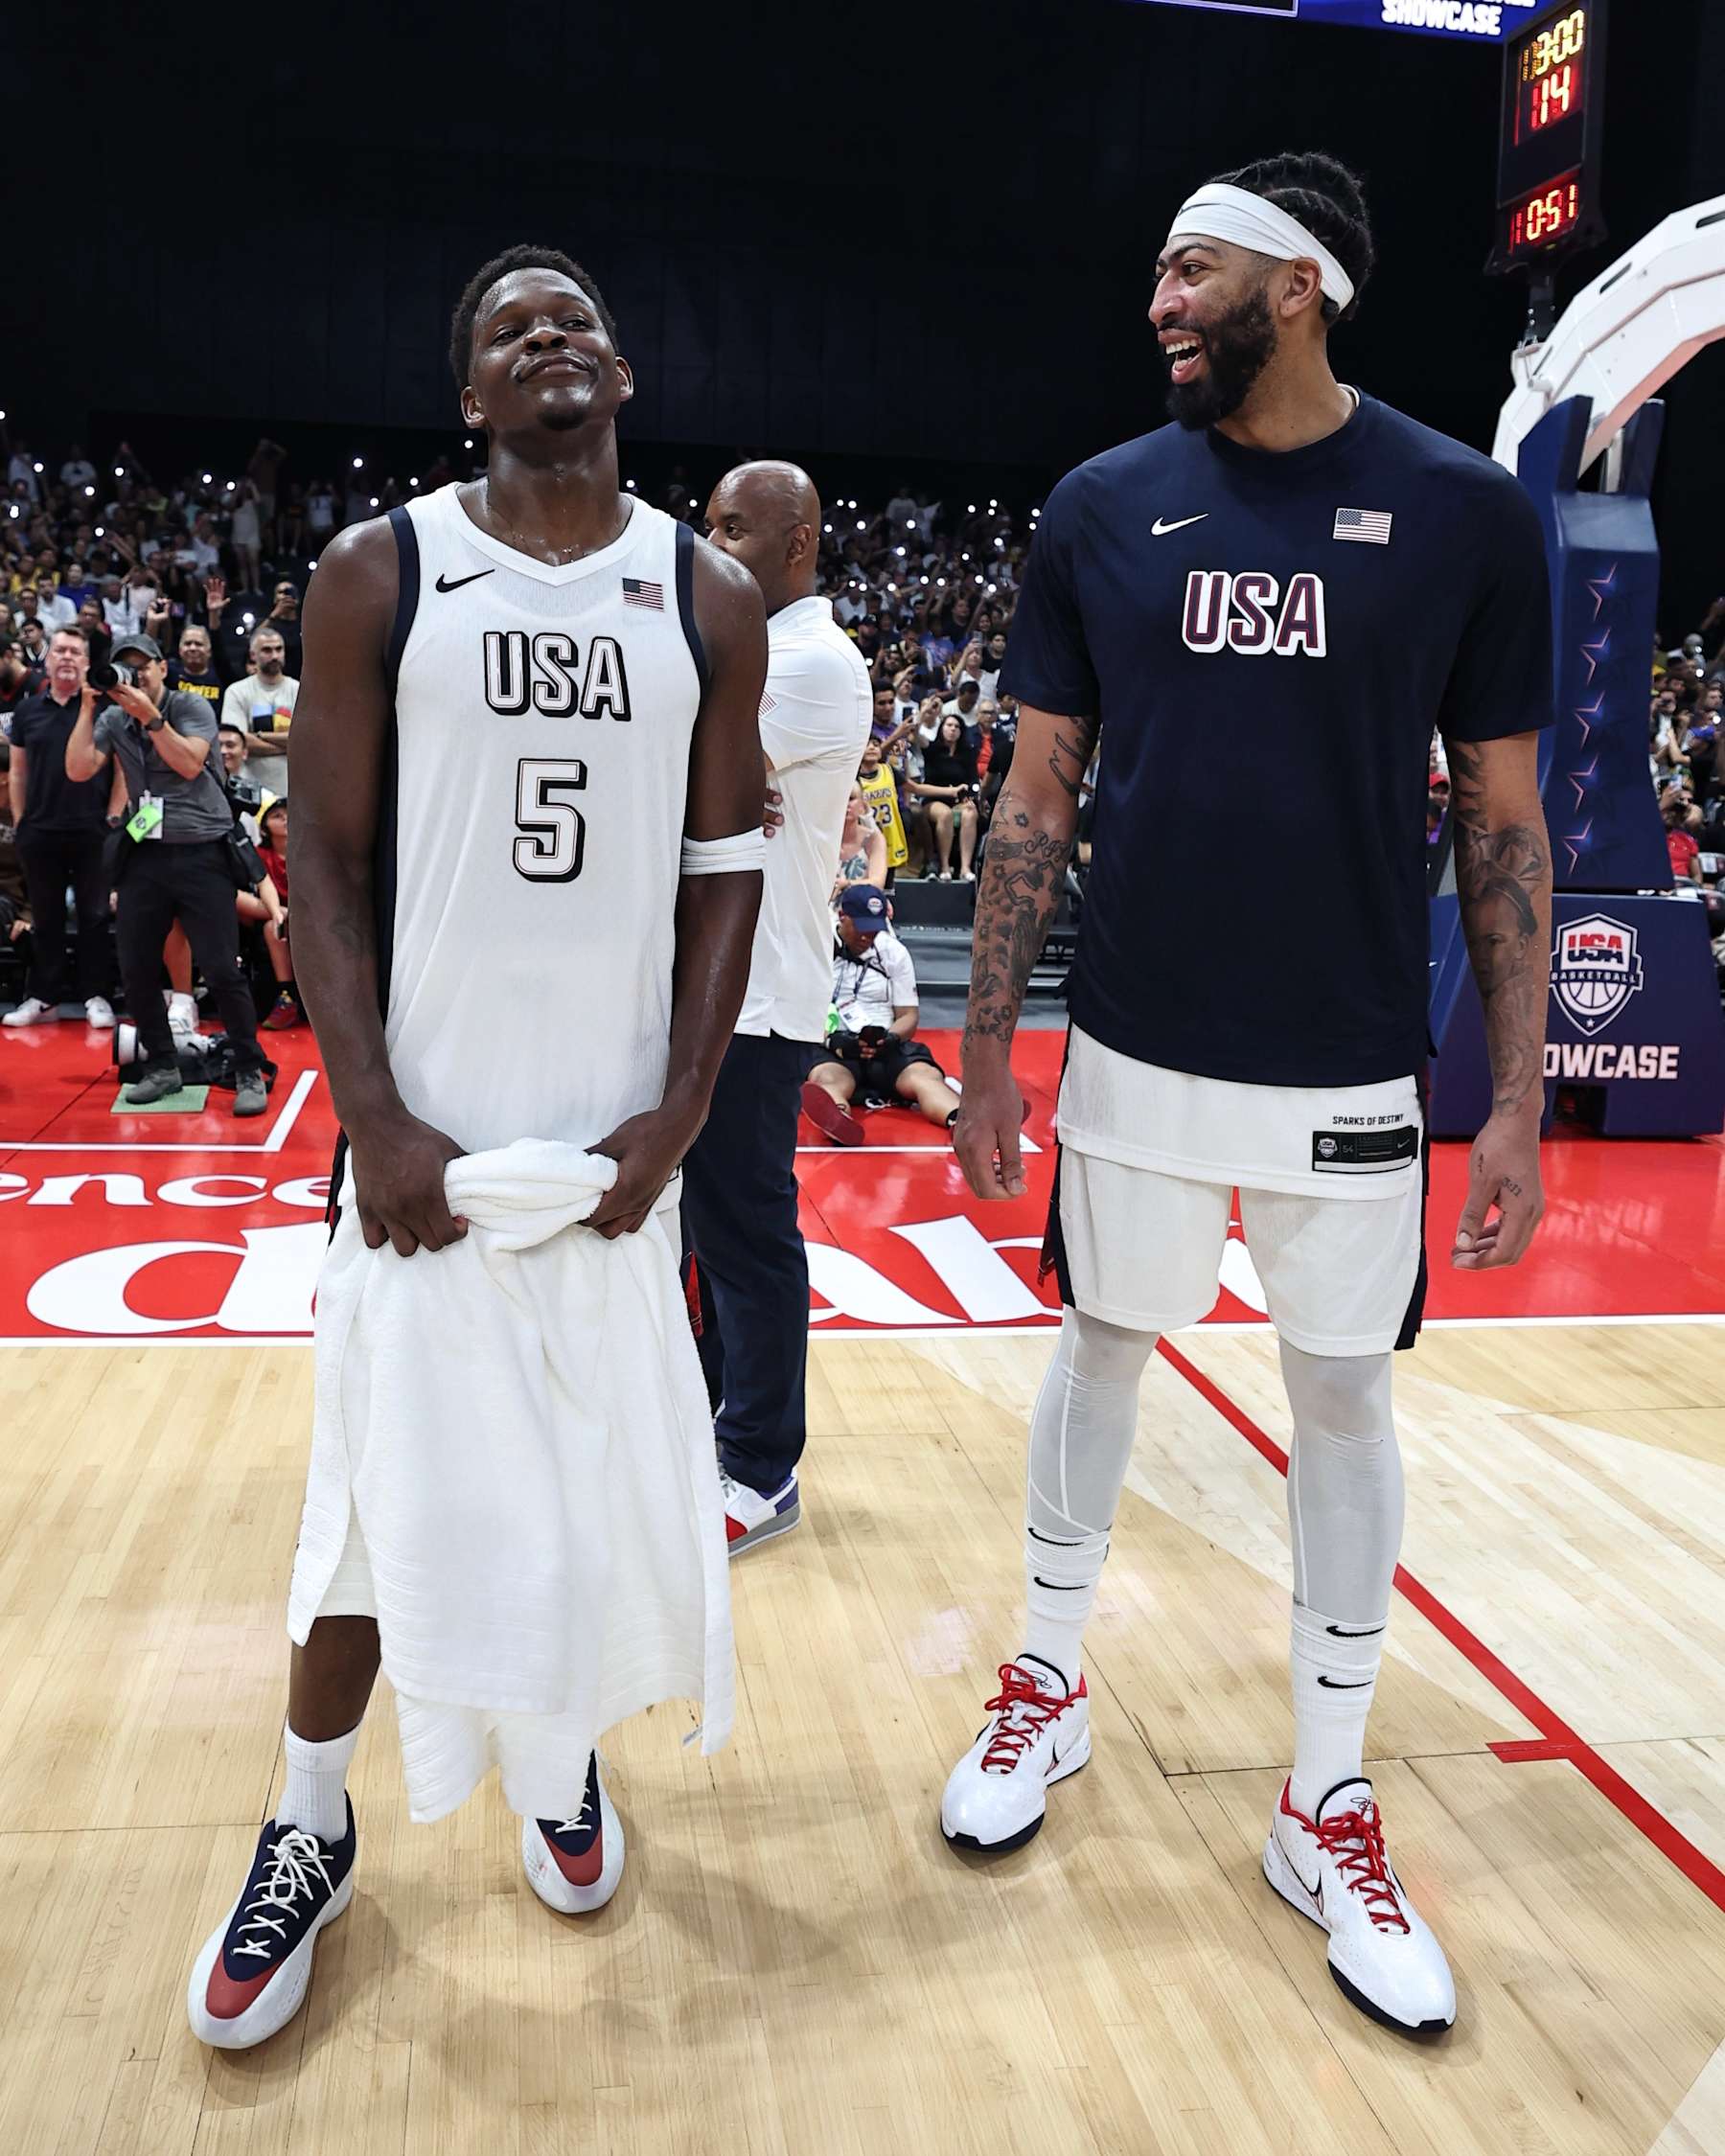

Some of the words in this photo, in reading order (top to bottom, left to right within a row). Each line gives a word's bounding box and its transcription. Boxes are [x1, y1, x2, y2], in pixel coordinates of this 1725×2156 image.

[1381, 0, 1502, 35] SHOWCASE
[1539, 65, 1572, 124] 14
[1183, 570, 1326, 657] USA
[483, 631, 632, 722] USA
[513, 758, 587, 883] 5
[1567, 933, 1624, 965] USA
[1551, 971, 1637, 984] BASKETBALL
[1333, 1115, 1365, 1126] SPARKS
[1367, 1116, 1376, 1126] OF
[1378, 1113, 1403, 1125] DESTINY
[0, 1173, 331, 1207] nce
